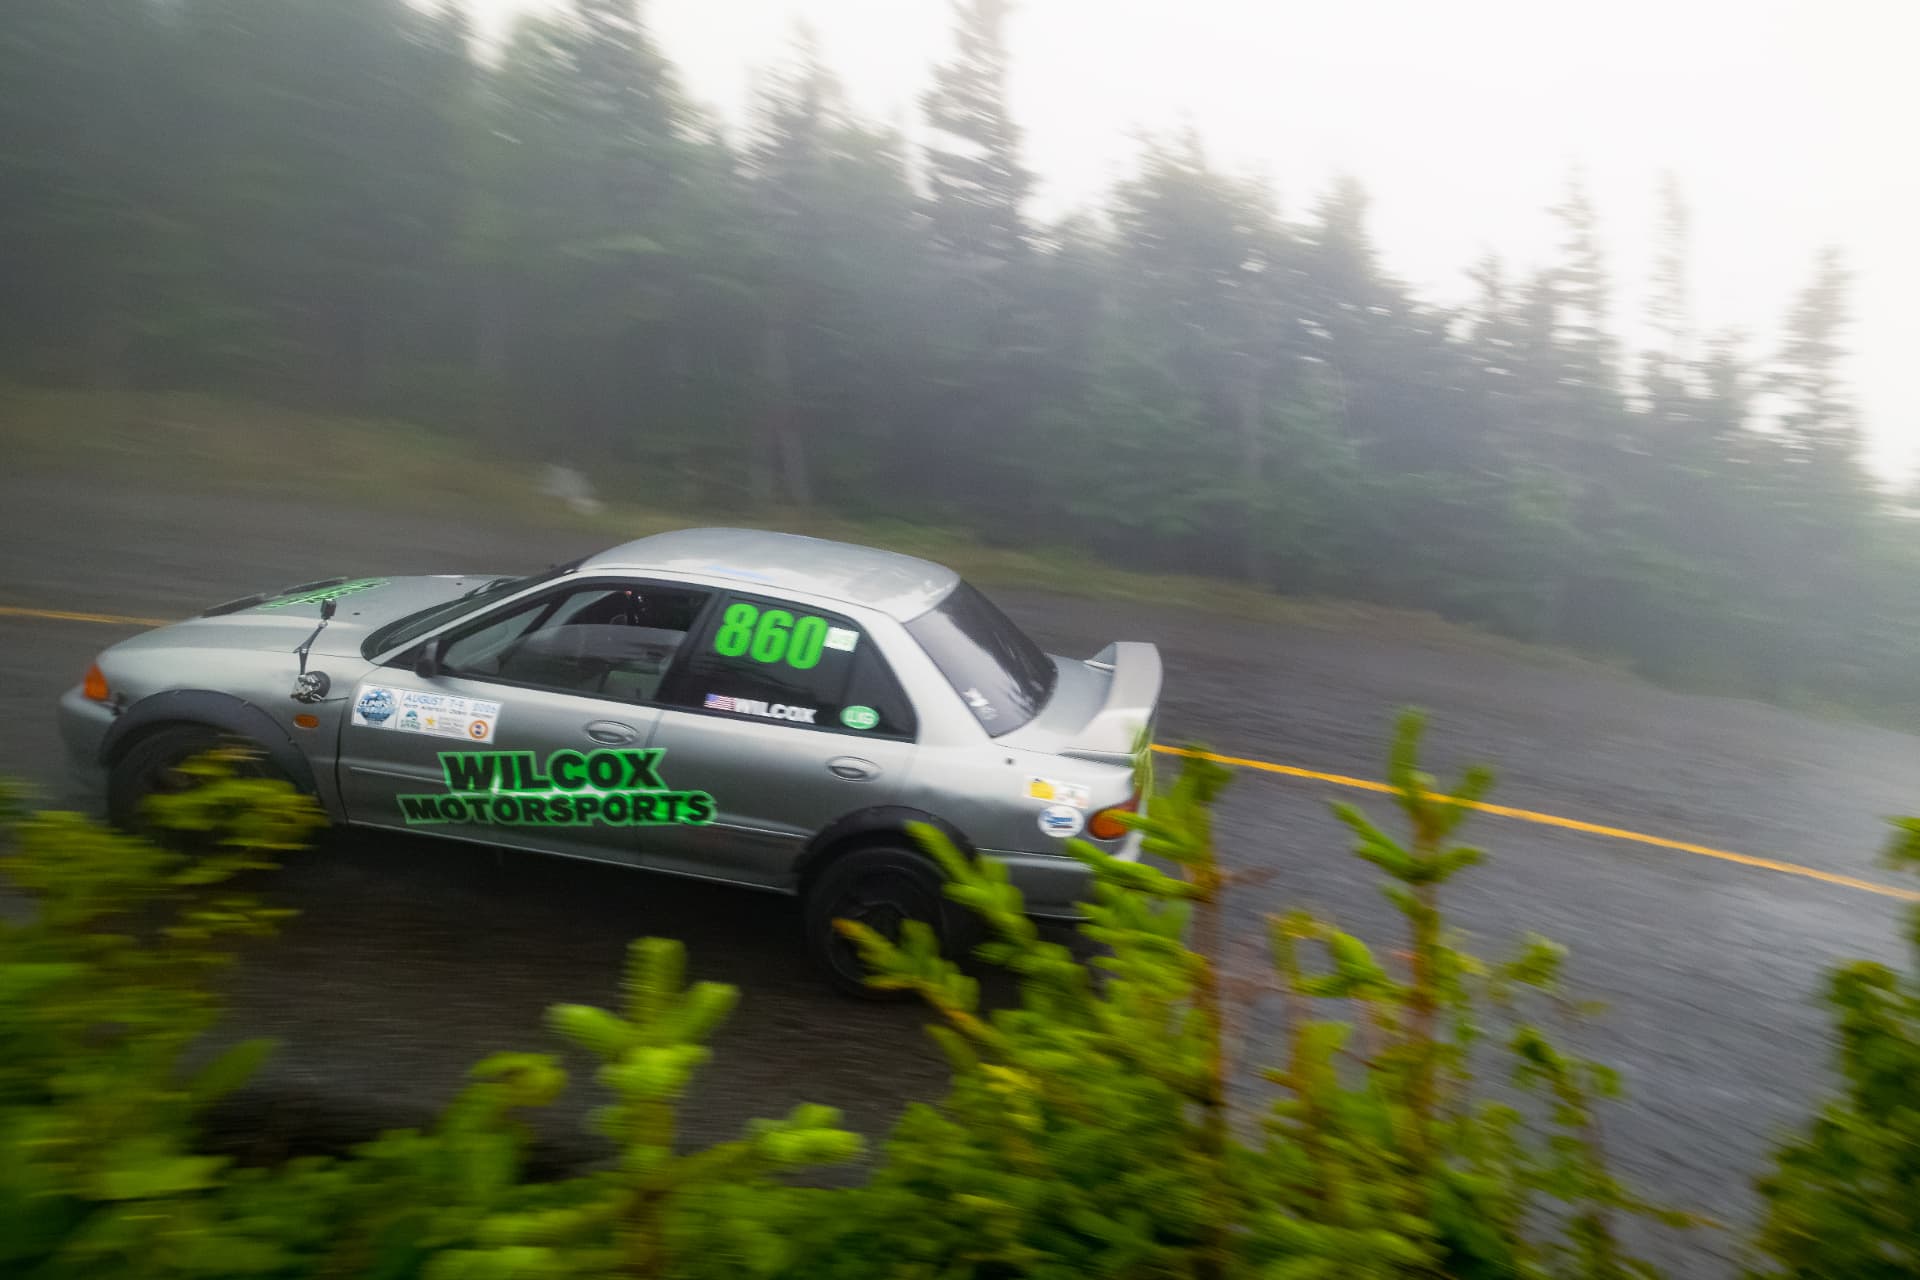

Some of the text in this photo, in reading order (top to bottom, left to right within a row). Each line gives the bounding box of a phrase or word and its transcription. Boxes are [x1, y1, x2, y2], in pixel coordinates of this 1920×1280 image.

[715, 603, 829, 669] 860
[404, 693, 444, 706] AUGUST
[734, 696, 817, 724] WILCOX
[439, 749, 667, 792] WILCOX
[398, 791, 715, 826] MOTORSPORTS
